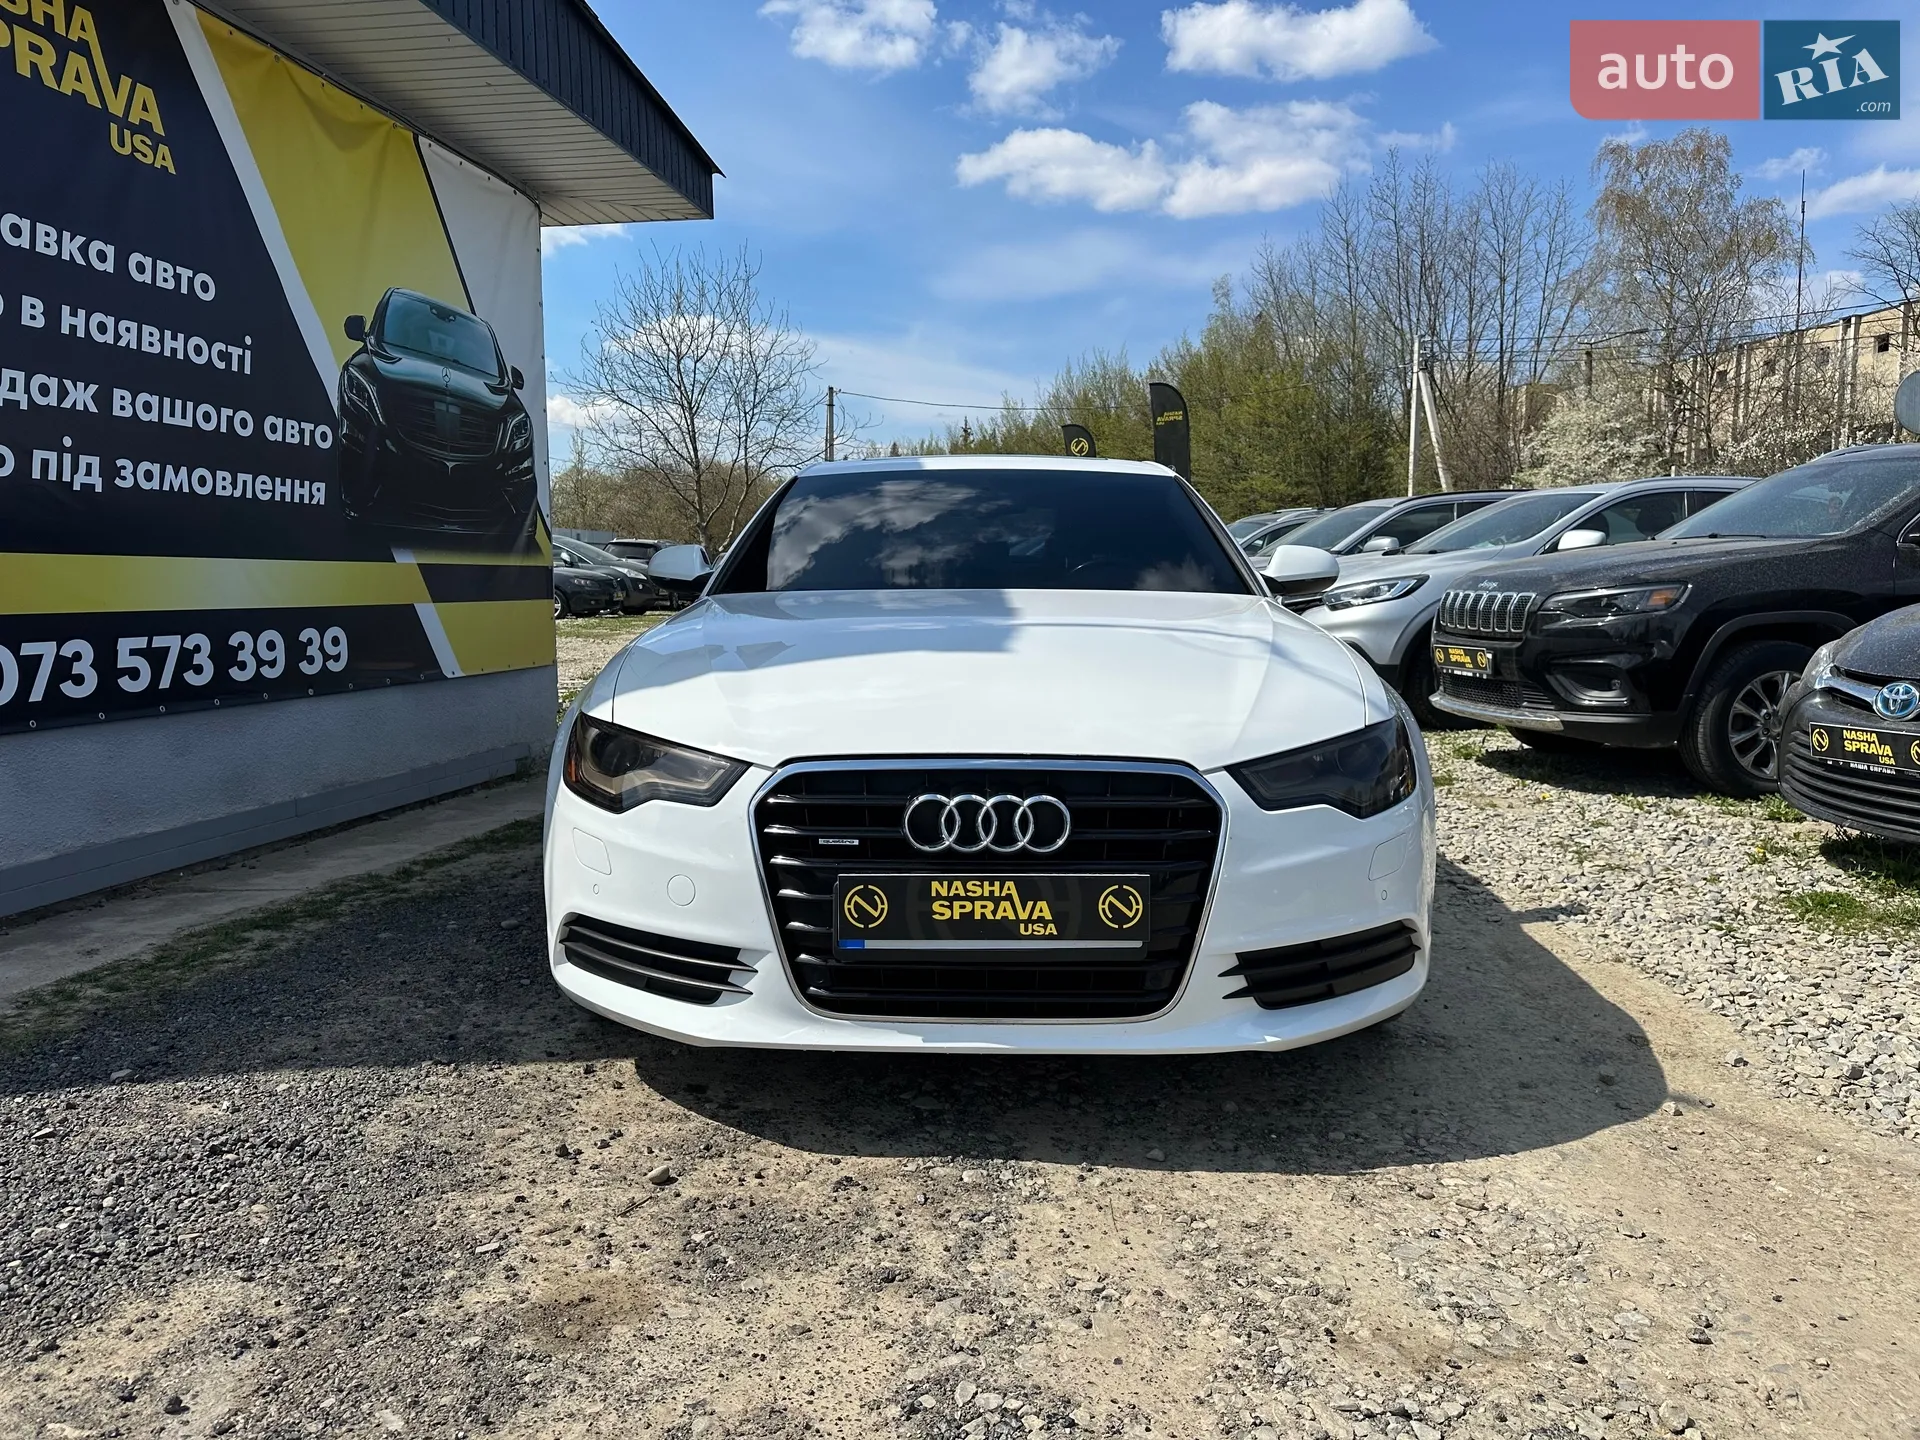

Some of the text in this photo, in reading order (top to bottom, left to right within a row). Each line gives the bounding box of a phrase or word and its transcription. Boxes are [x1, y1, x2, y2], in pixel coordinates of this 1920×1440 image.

[110, 122, 177, 175] USA
[0, 213, 216, 301] авка авто
[21, 295, 45, 328] в
[60, 304, 252, 375] наявності
[0, 367, 334, 449] даж вашого авто
[31, 435, 103, 492] під
[114, 458, 326, 505] замовлення
[117, 633, 214, 693] 573
[228, 629, 286, 682] 39
[298, 626, 349, 675] 39
[1843, 730, 1877, 742] NASHA
[1844, 740, 1893, 757] SPRAVA
[1878, 756, 1896, 765] USA
[931, 880, 1016, 897] NASHA
[932, 900, 1053, 921] SPRAVA
[1019, 923, 1058, 936] USA
